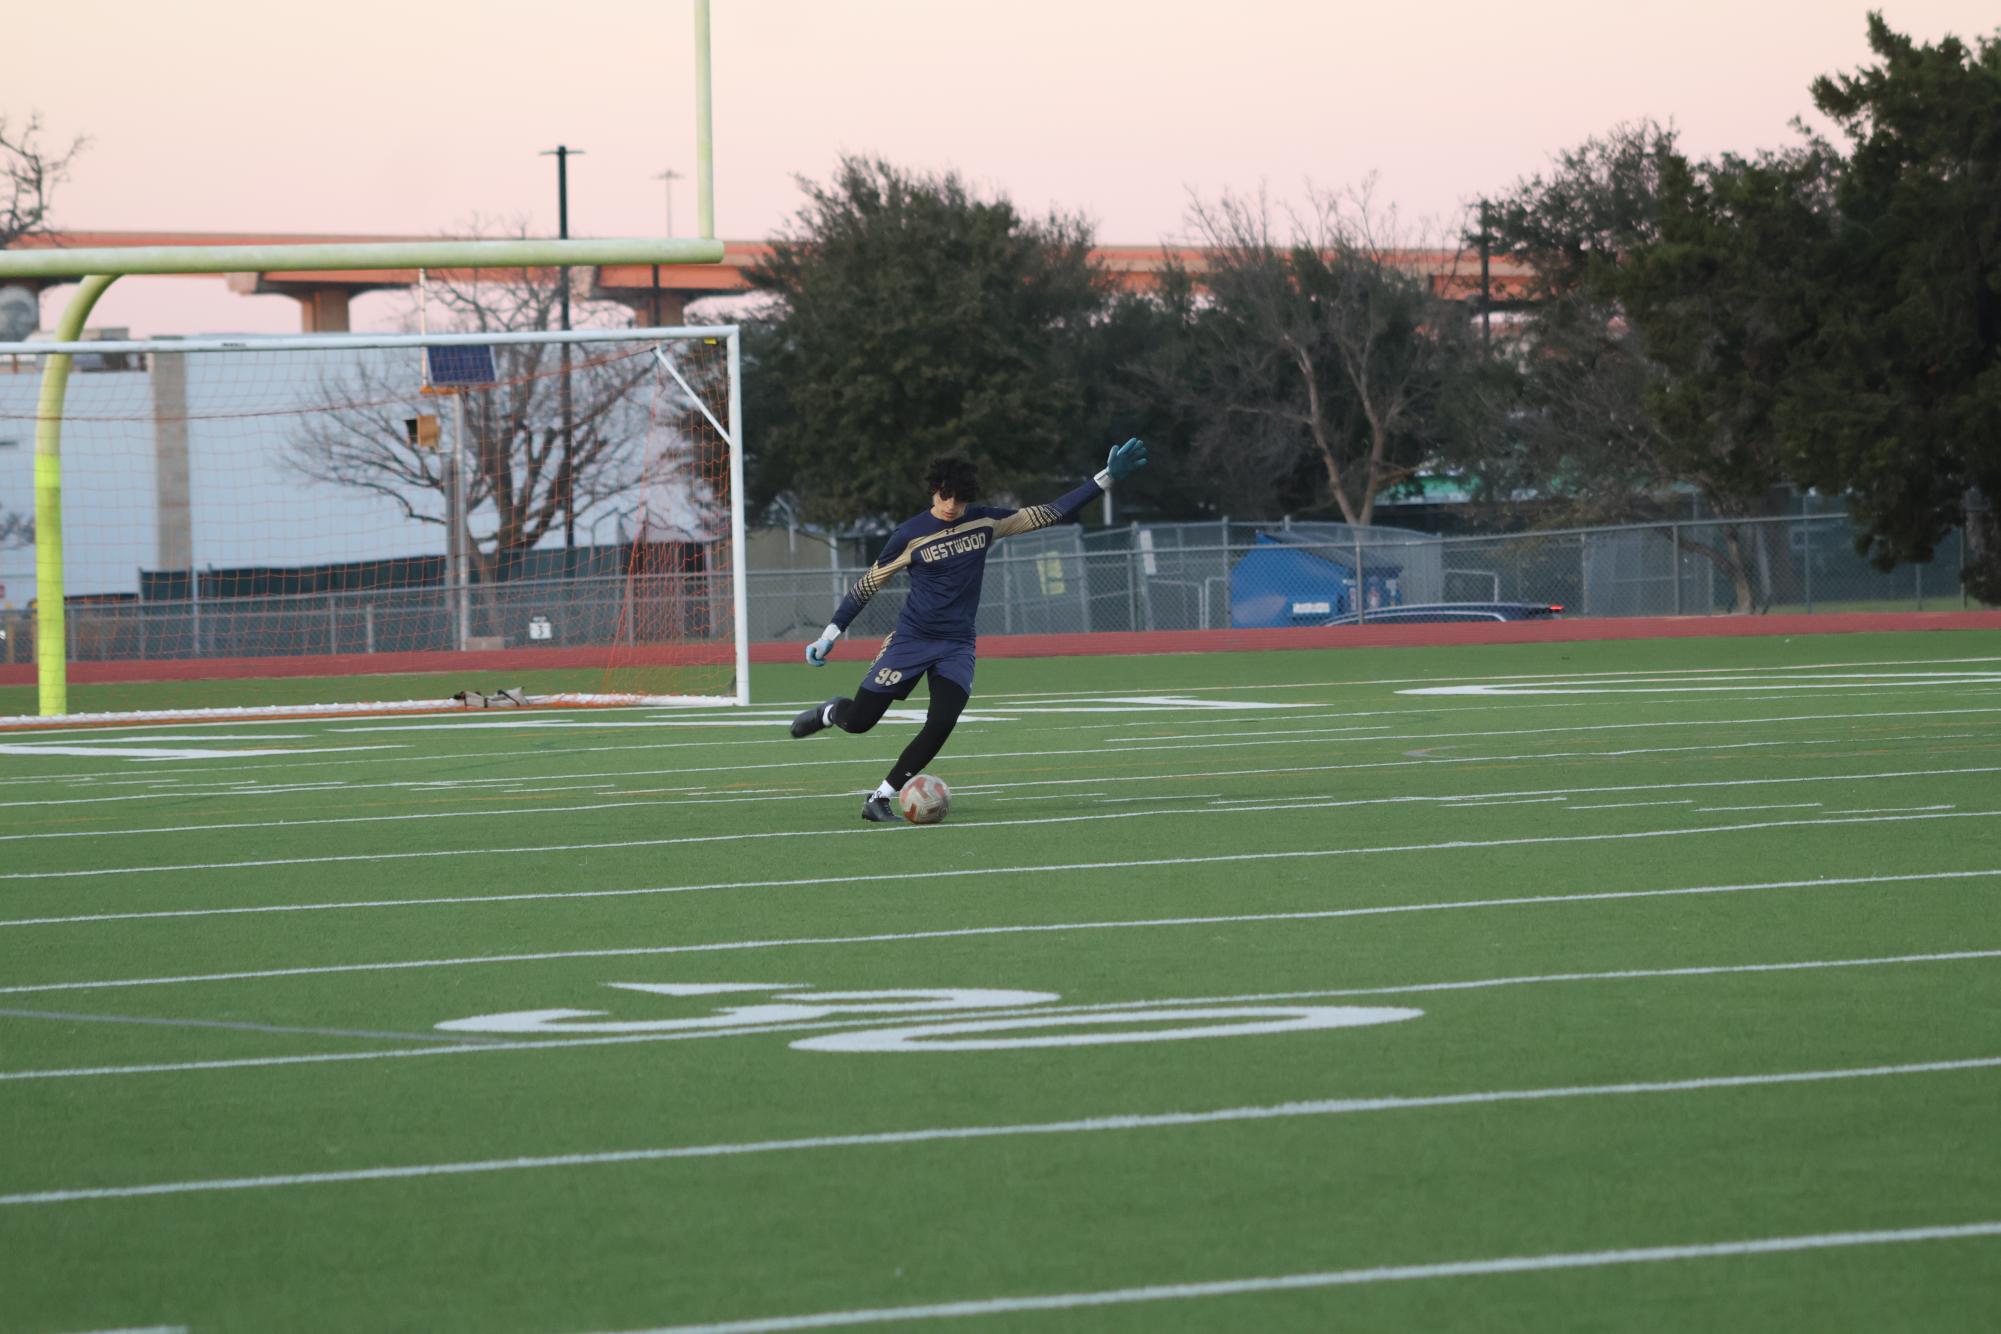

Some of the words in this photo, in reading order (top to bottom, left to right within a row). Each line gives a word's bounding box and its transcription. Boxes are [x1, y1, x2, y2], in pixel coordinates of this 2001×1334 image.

[920, 532, 986, 563] WESTWOOD
[874, 667, 903, 687] 99
[435, 987, 1426, 1053] 30
